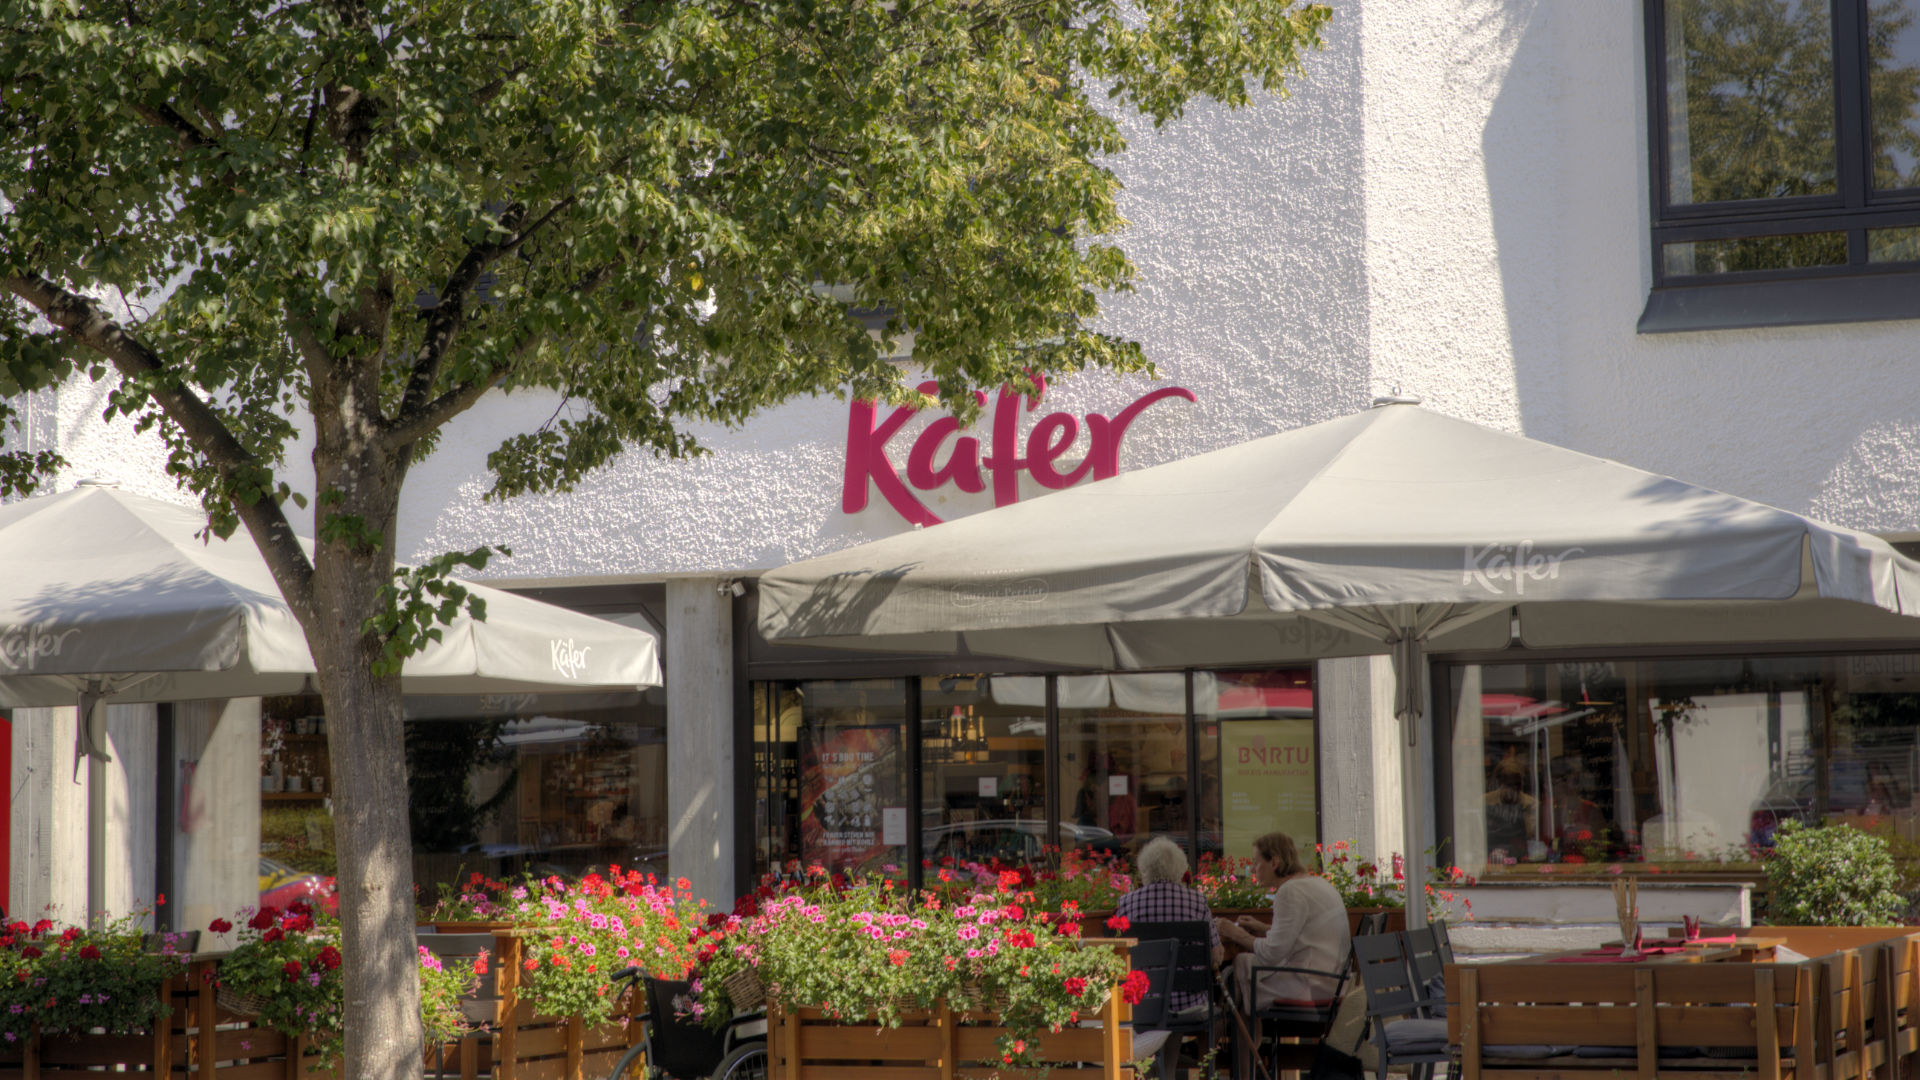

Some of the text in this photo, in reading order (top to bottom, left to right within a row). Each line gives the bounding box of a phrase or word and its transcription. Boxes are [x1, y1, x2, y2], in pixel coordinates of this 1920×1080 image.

[1463, 540, 1585, 595] Käfer
[551, 638, 592, 679] Käfer
[856, 752, 874, 761] TIME
